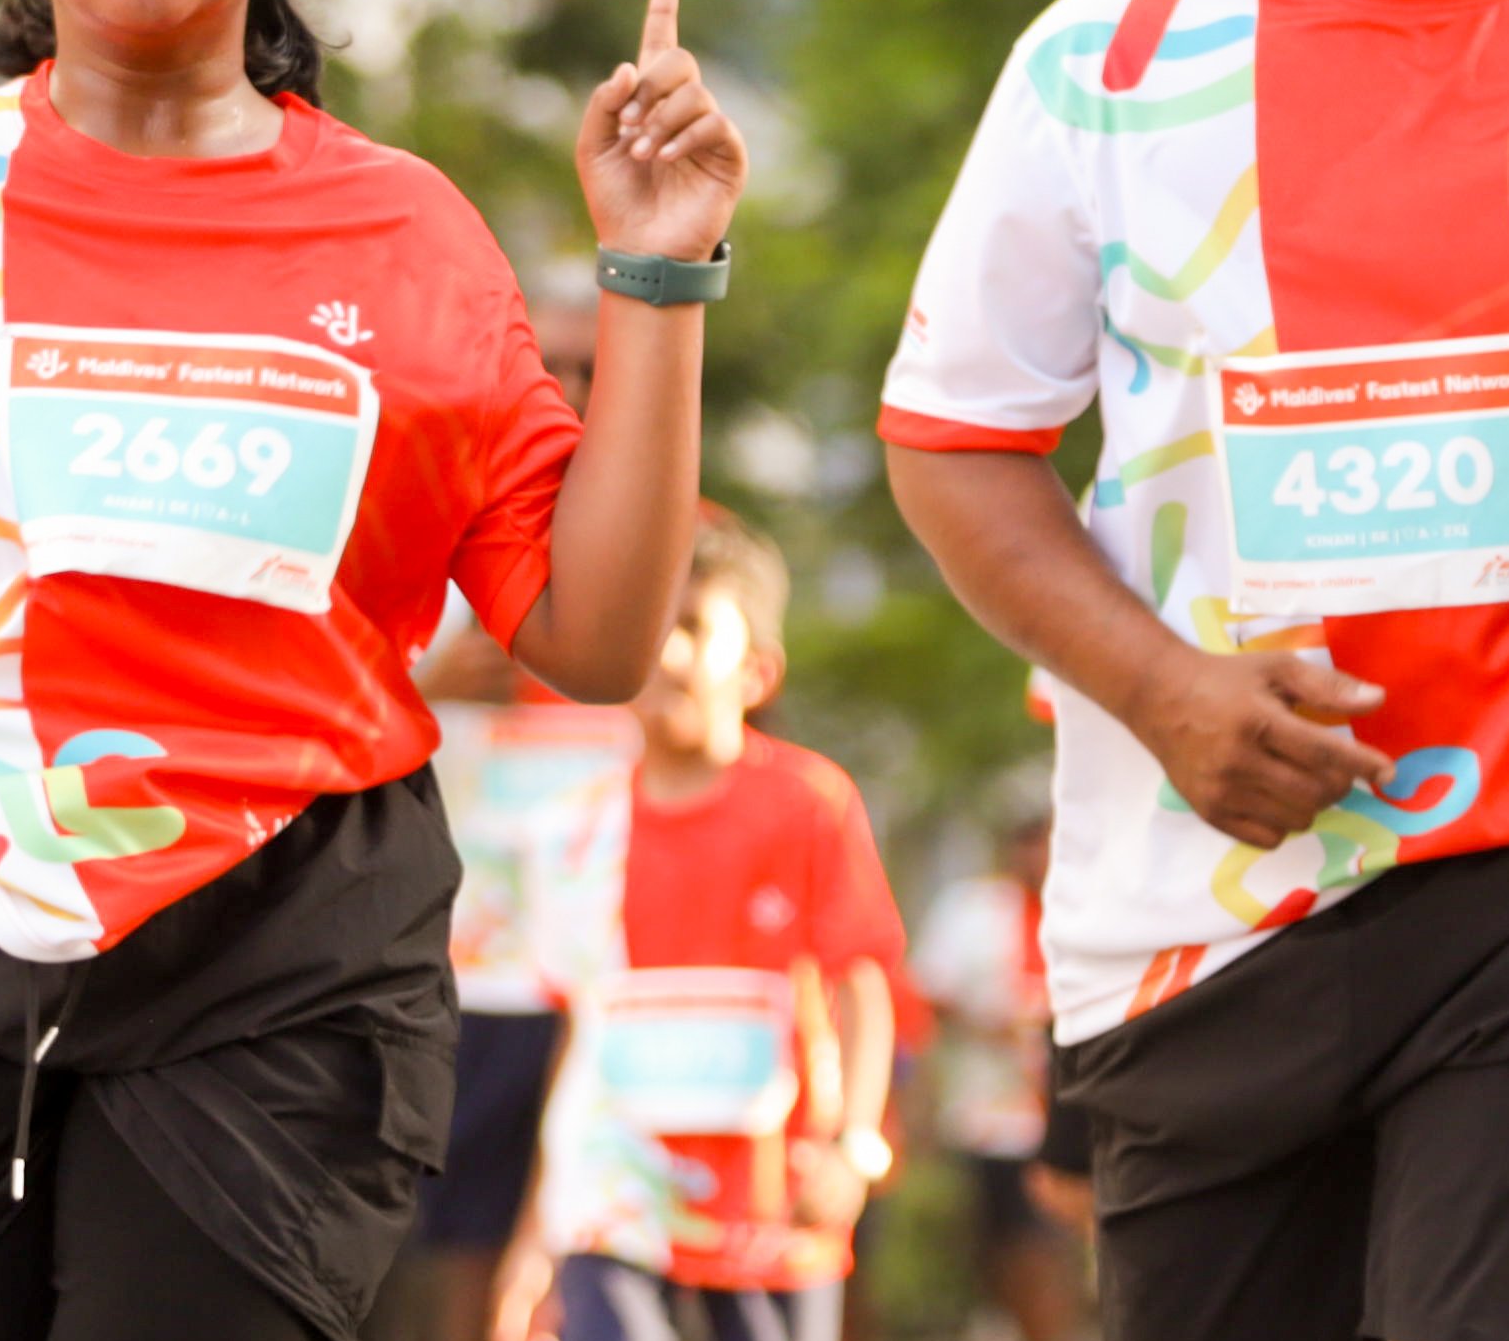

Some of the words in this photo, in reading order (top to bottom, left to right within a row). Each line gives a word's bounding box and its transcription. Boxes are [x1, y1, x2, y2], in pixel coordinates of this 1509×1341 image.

[178, 362, 254, 385] Fastest
[259, 366, 346, 399] Network
[1270, 385, 1360, 409] Maldives'
[1366, 377, 1439, 401] Fastest
[69, 412, 291, 496] 2669
[1272, 436, 1494, 517] 4320
